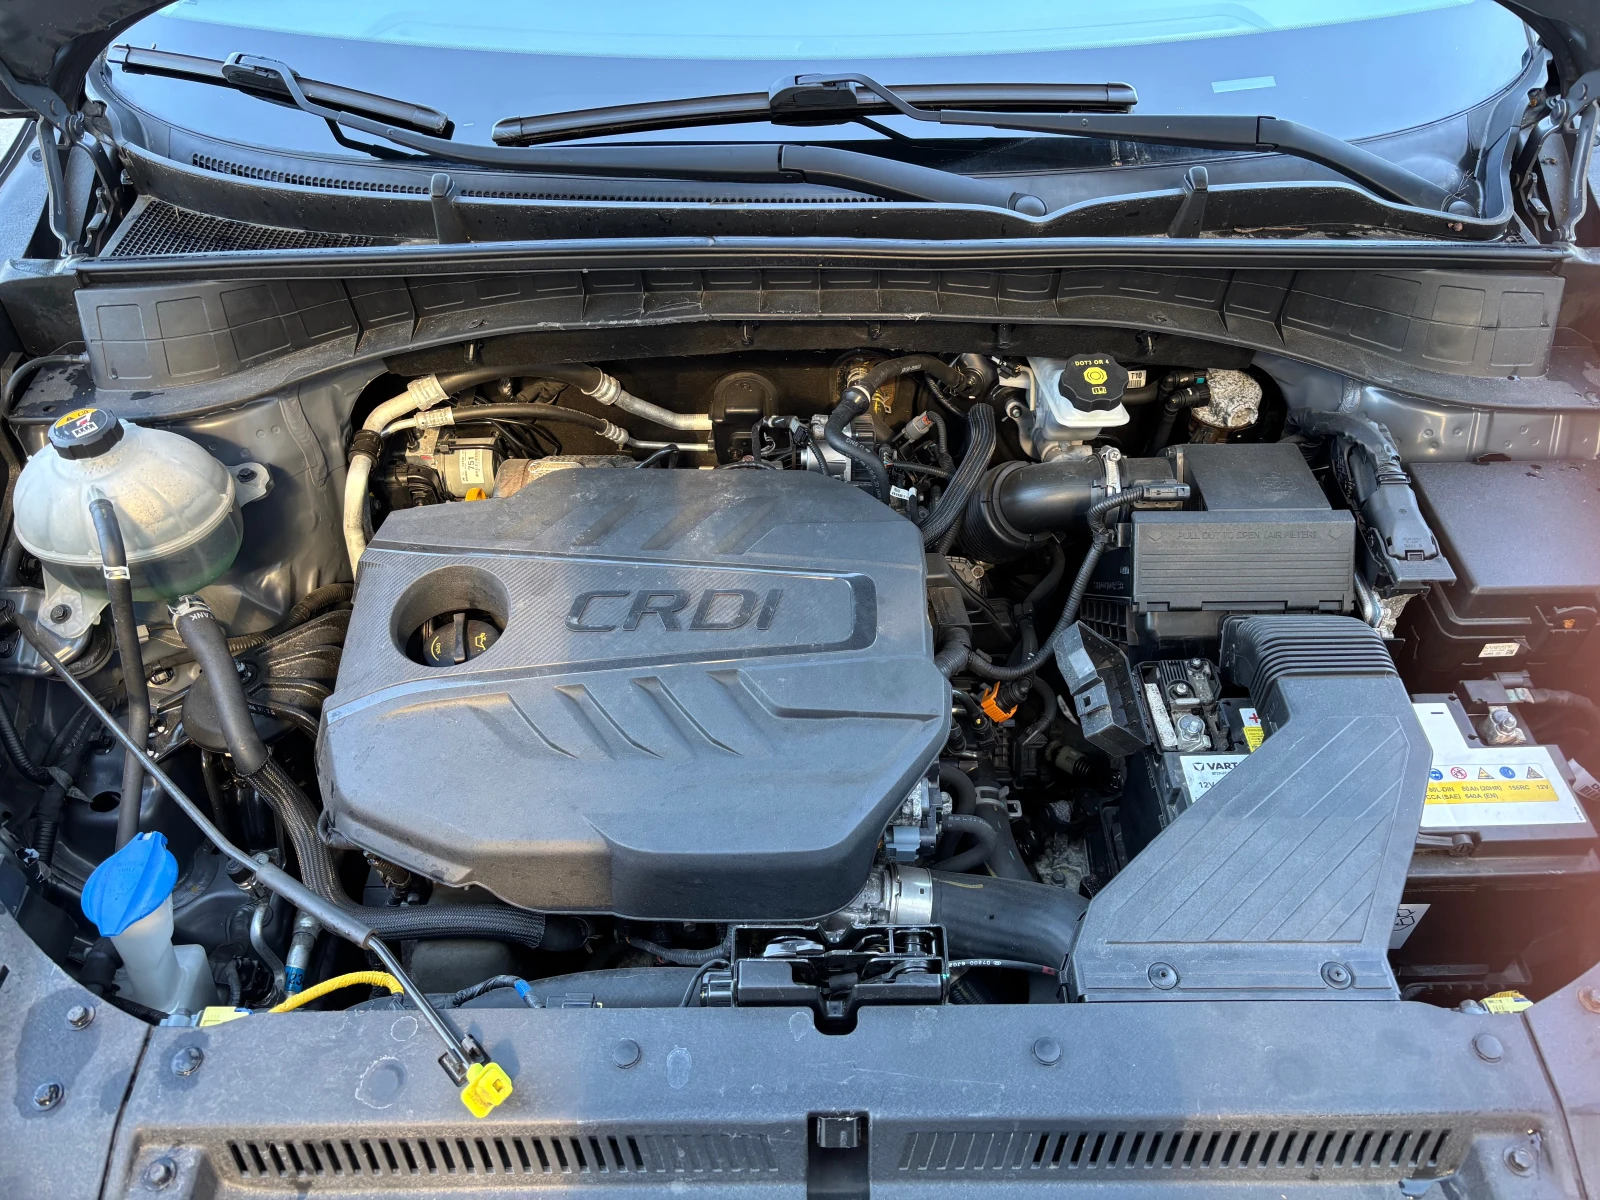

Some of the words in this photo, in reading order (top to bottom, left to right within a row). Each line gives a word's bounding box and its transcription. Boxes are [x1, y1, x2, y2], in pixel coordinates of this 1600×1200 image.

[1178, 531, 1200, 540] PULL
[1202, 531, 1220, 539] OUT
[1237, 531, 1260, 539] OPEN
[564, 588, 783, 632] CRDI
